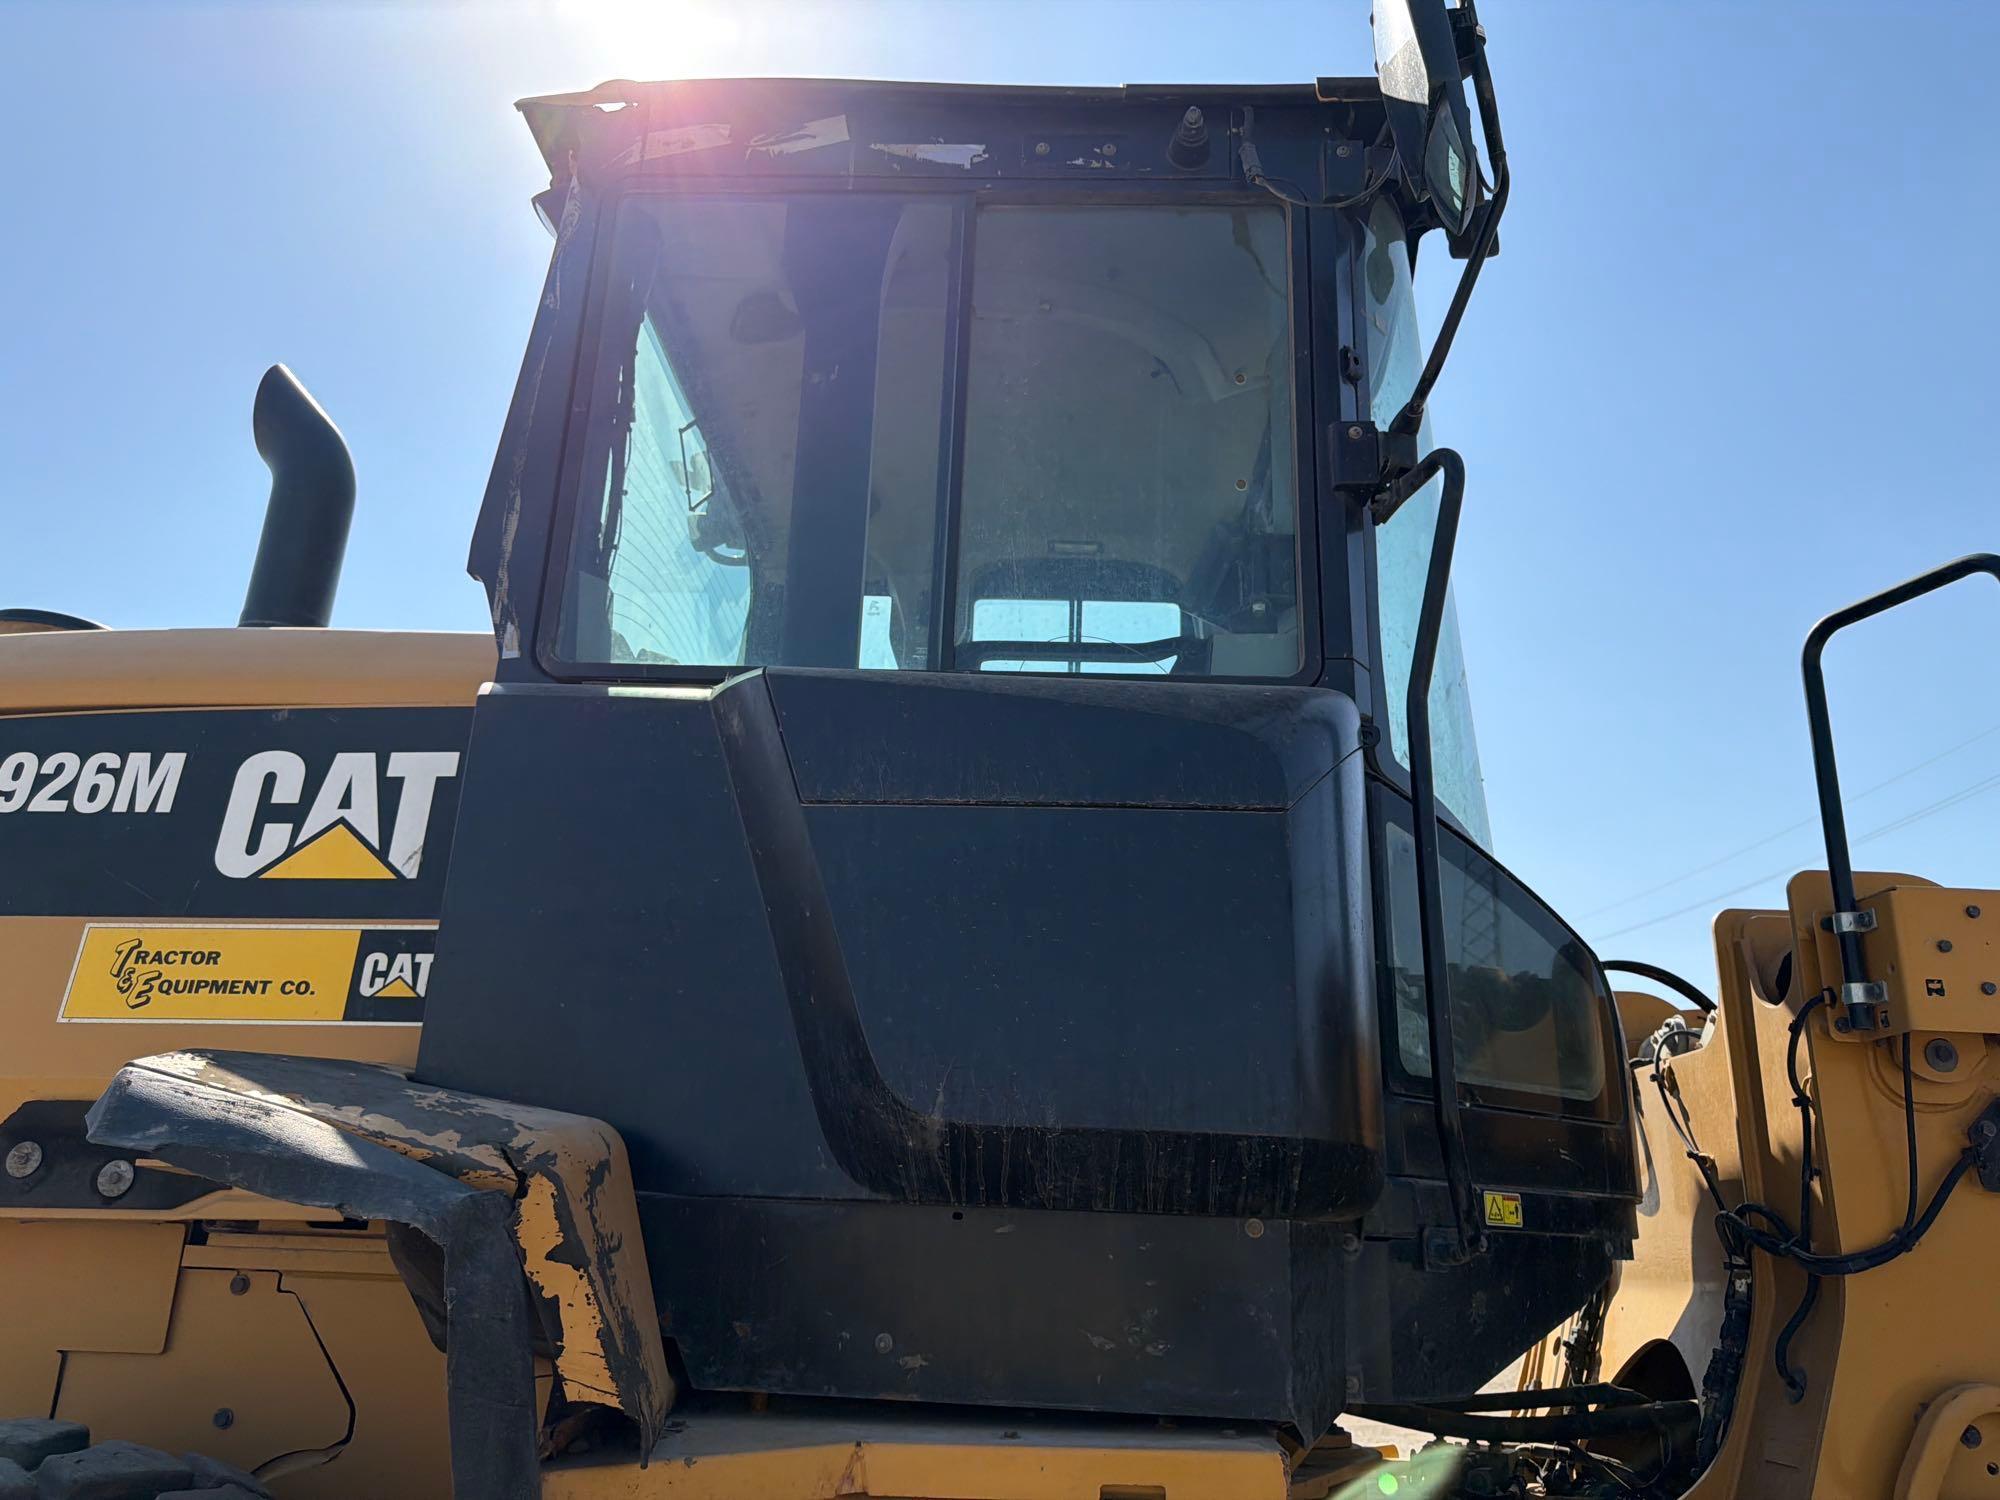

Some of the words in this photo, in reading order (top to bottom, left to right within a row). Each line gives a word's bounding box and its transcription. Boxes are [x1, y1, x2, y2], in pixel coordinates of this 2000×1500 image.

[0, 752, 187, 813] 926M
[214, 750, 460, 879] CAT
[110, 938, 221, 977] TRACTOR
[359, 952, 434, 998] CAT
[126, 970, 272, 1009] EQUIPMENT
[280, 979, 315, 996] CO.
